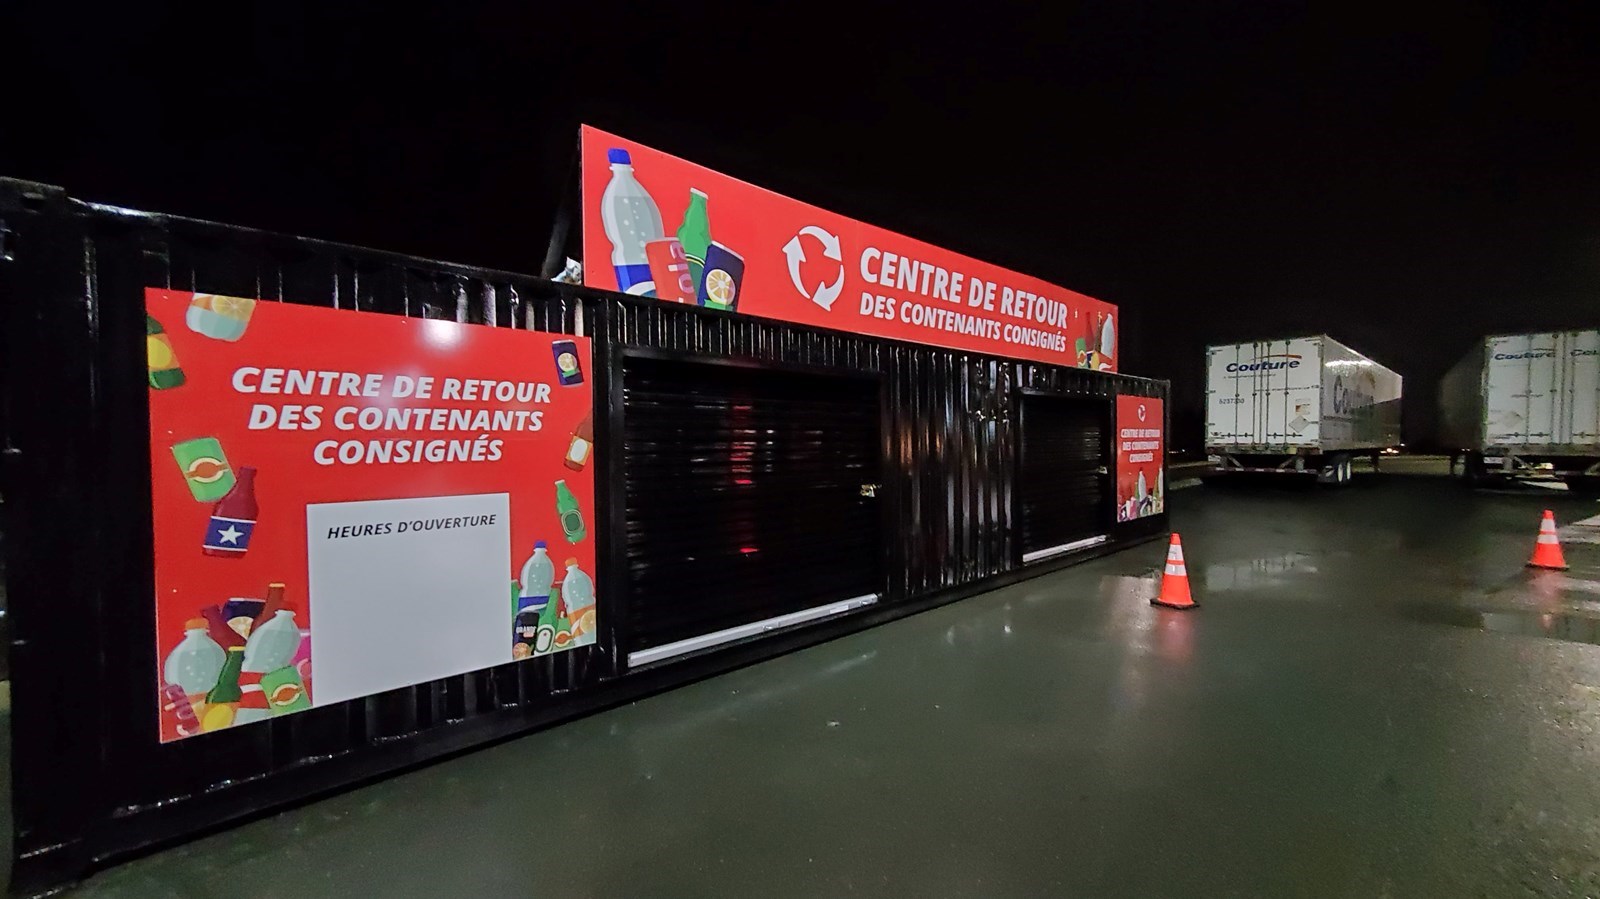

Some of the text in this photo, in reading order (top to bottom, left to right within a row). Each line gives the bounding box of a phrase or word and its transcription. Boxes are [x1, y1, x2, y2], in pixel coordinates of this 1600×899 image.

[861, 247, 1068, 328] CENTRE DE RETOUR
[859, 292, 1067, 352] DES CONTENANTS CONSIGNÉS
[1226, 360, 1300, 373] Couture
[232, 367, 551, 403] CENTRE DE RETOUR
[249, 405, 543, 431] DES CONTENANTS
[313, 434, 503, 464] CONSIGNÉS
[327, 523, 392, 539] HEURES
